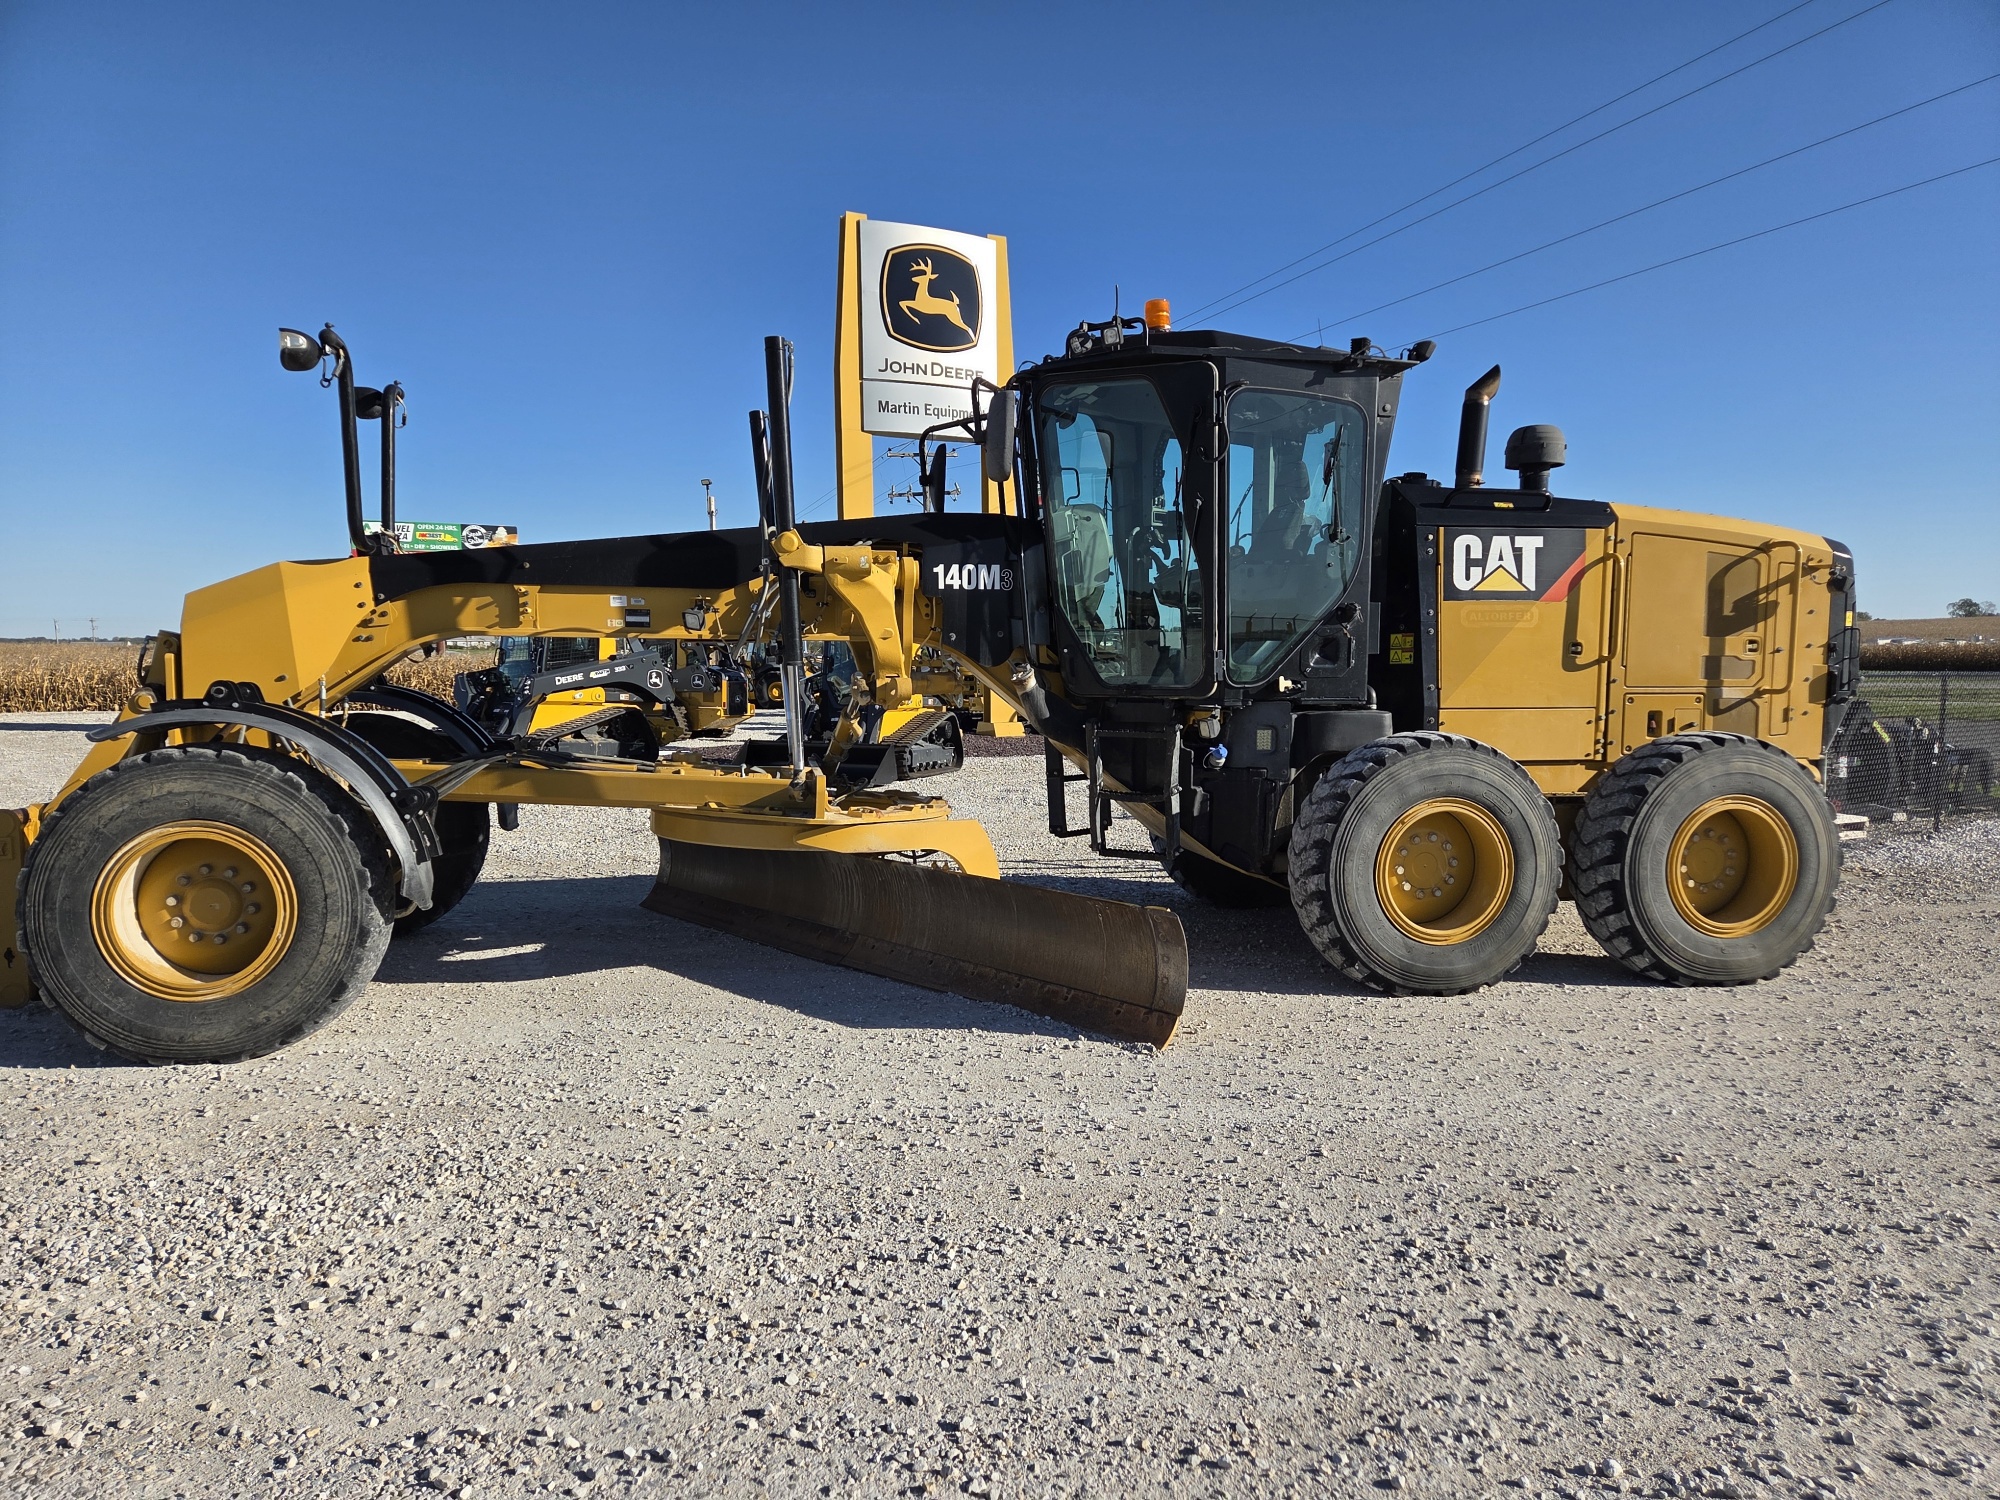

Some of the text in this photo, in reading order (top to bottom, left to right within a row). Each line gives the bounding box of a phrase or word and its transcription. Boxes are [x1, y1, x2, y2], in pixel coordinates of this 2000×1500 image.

[878, 357, 984, 381] JOHN DEERE
[877, 400, 986, 421] Martin Equipme
[1453, 534, 1544, 592] CAT
[1469, 611, 1531, 621] ALTORFER
[555, 672, 584, 685] DEERE
